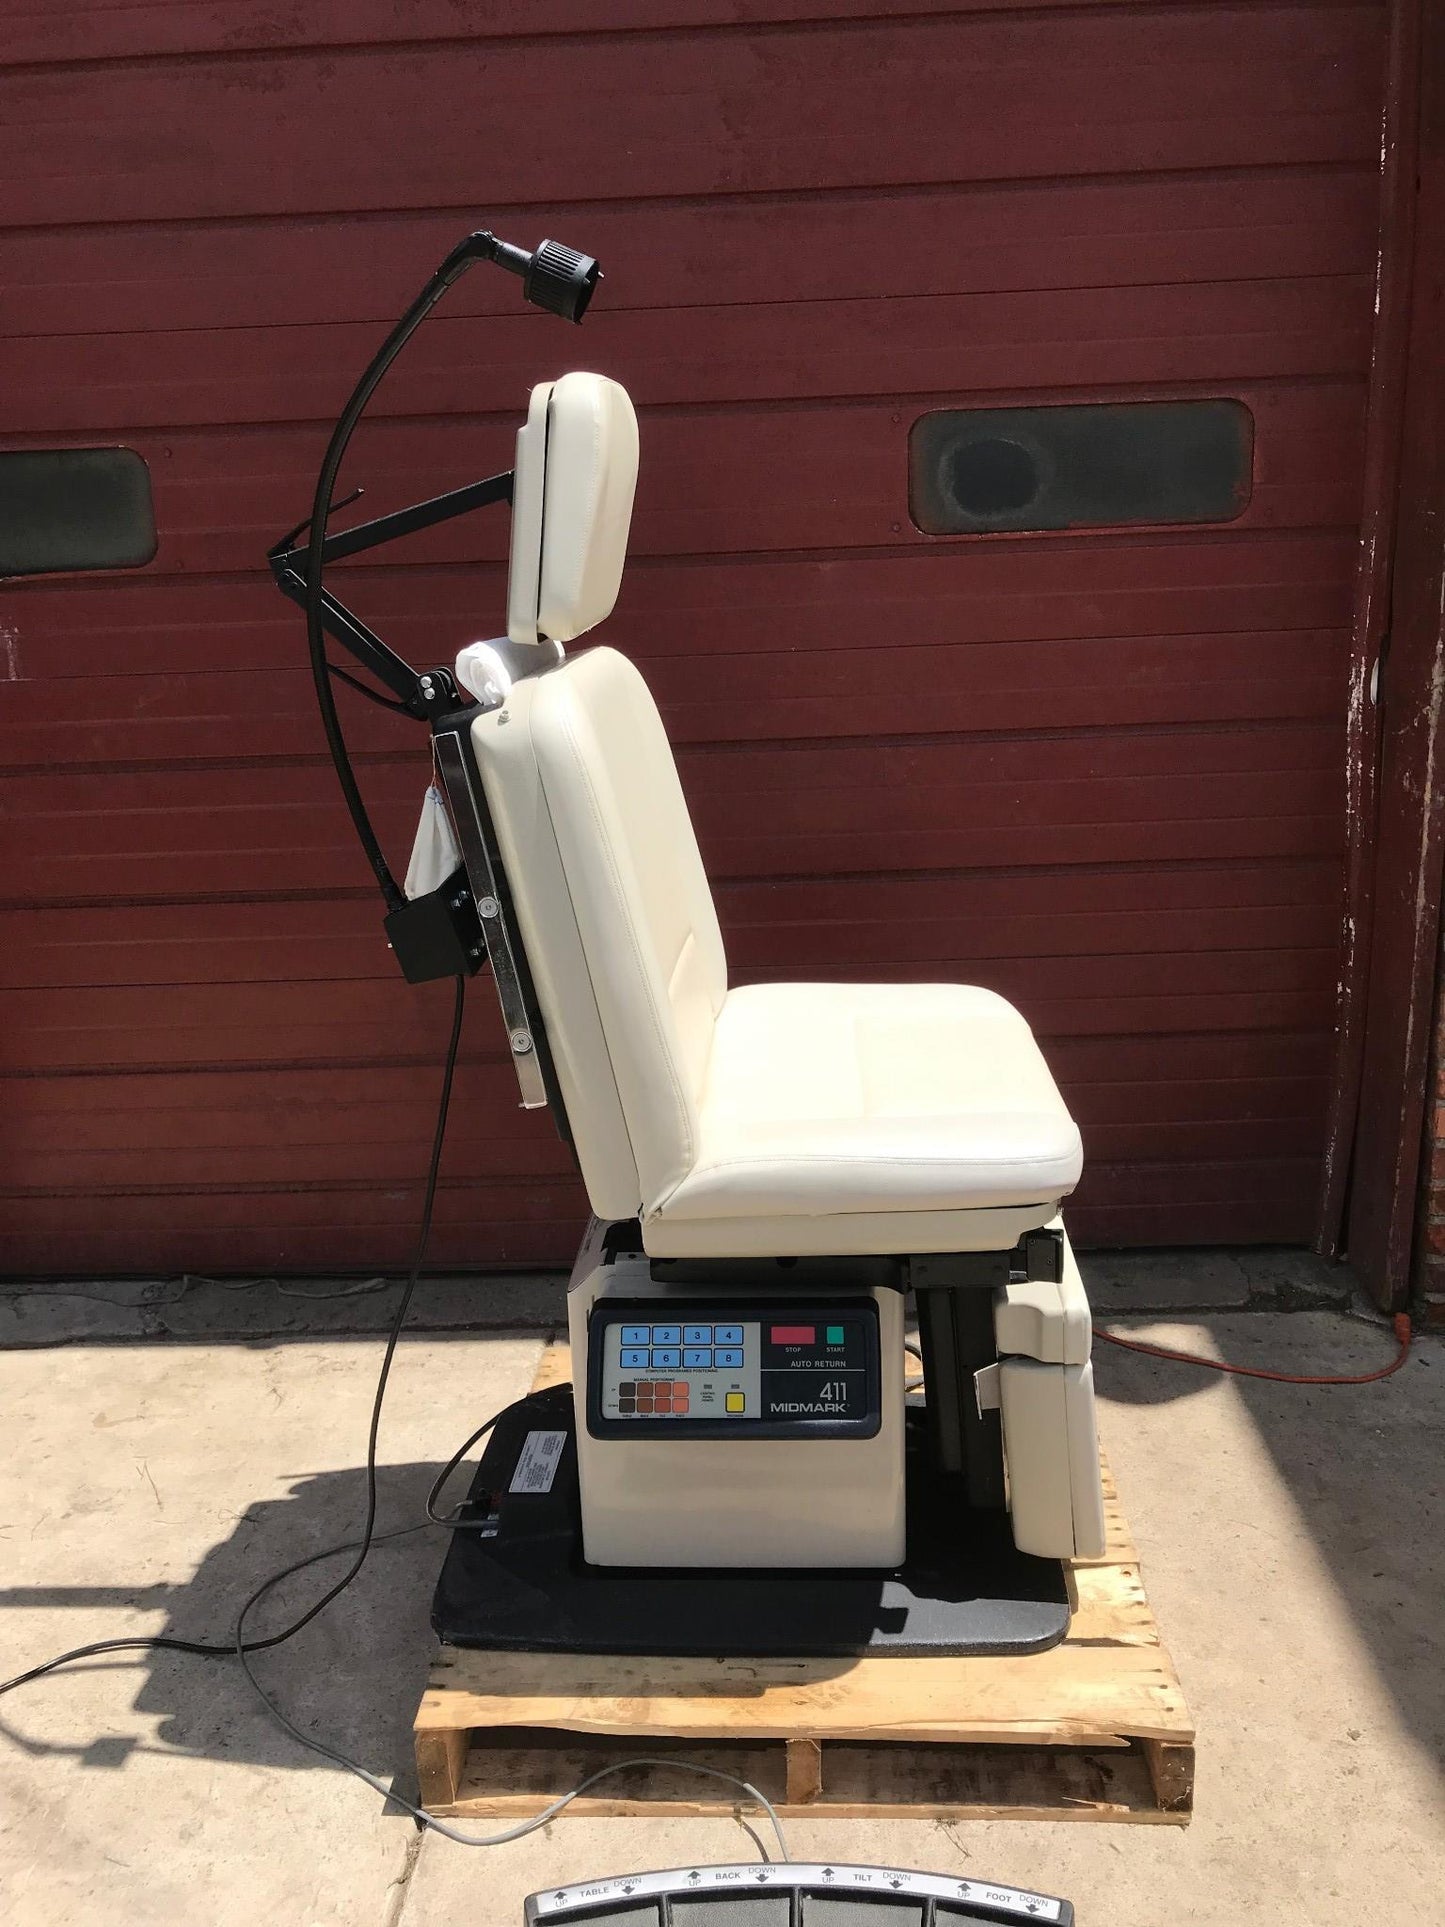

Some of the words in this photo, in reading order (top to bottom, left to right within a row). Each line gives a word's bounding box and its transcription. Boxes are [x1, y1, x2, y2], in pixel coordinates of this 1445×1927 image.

[633, 1332, 638, 1340] 1
[664, 1332, 670, 1340] 2
[695, 1332, 701, 1340] 3
[726, 1332, 732, 1340] 4
[633, 1354, 638, 1362] 5
[663, 1354, 670, 1362] 6
[695, 1354, 700, 1362] 7
[725, 1354, 732, 1362] 8
[820, 1382, 847, 1401] 411
[770, 1403, 847, 1412] MIDMARK
[688, 1879, 701, 1887] UP
[715, 1871, 741, 1880] BACK
[748, 1867, 776, 1875] DOWN
[822, 1876, 835, 1884] UP
[853, 1874, 872, 1882] TILT
[882, 1871, 911, 1882] DOWN
[555, 1899, 568, 1908] UP
[580, 1886, 610, 1898] TABLE
[613, 1877, 642, 1888] DOWN
[957, 1891, 970, 1899] UP
[986, 1891, 1012, 1903] FOOT
[1019, 1894, 1049, 1908] DOWN
